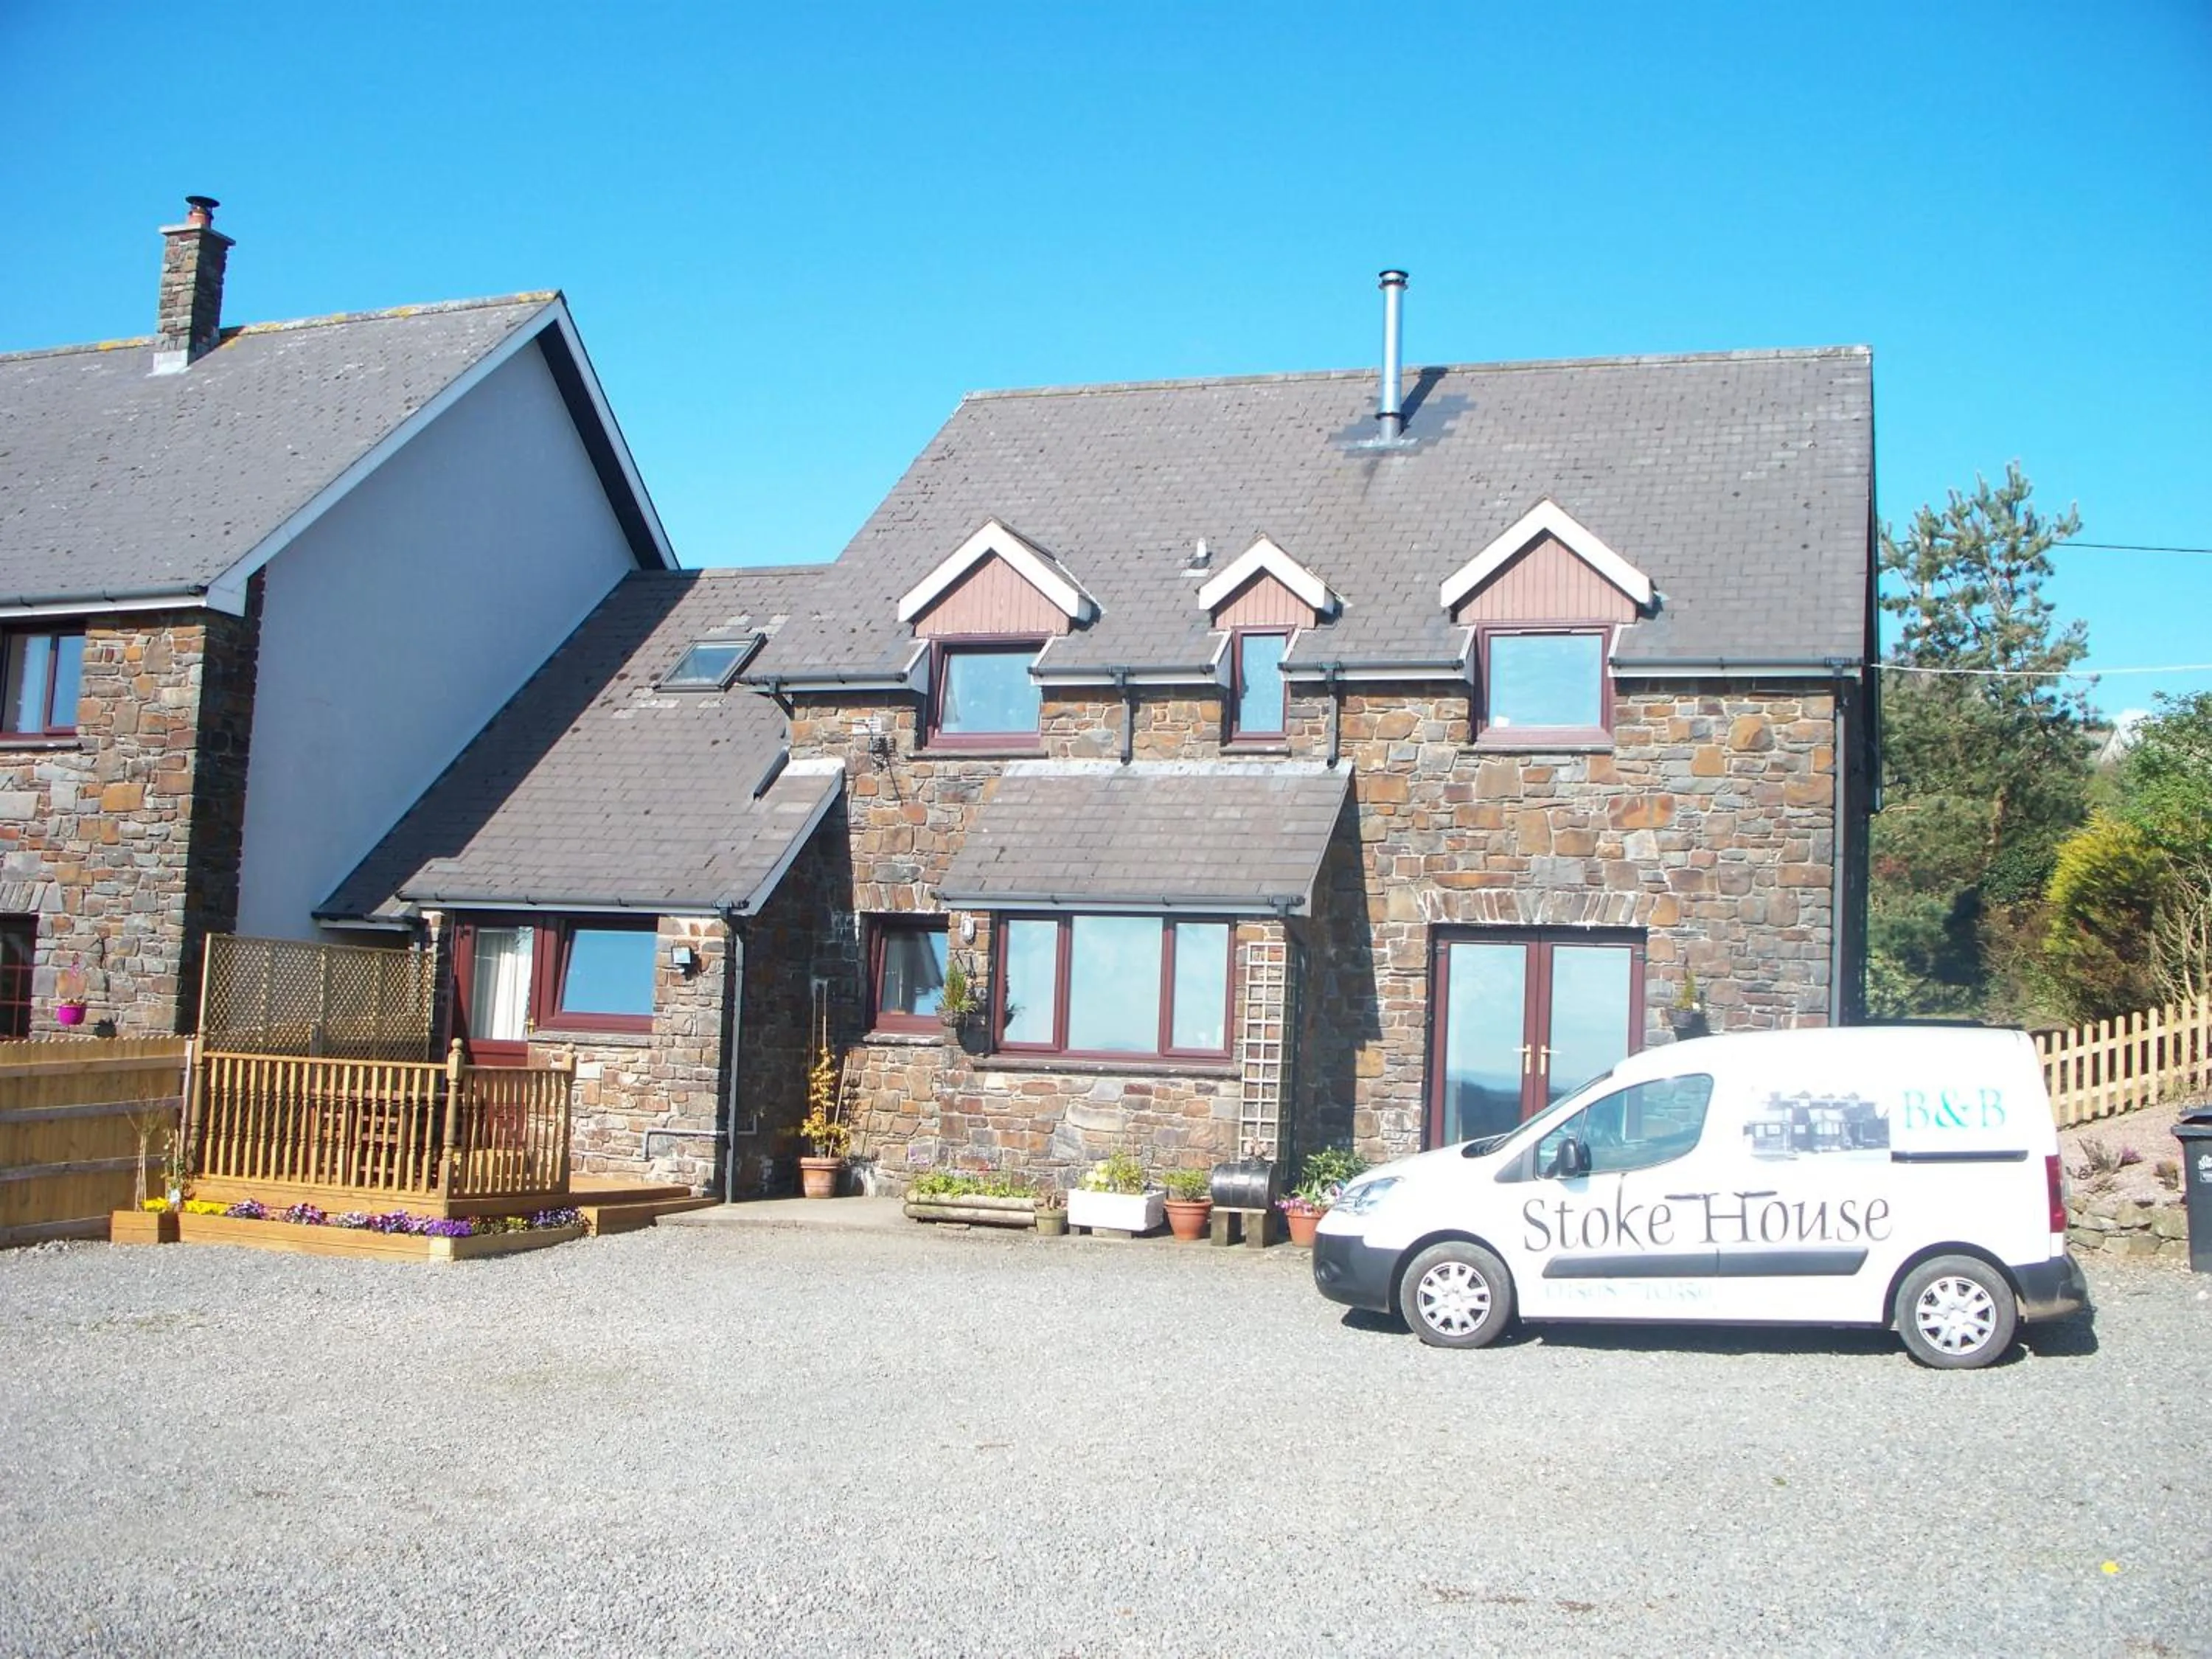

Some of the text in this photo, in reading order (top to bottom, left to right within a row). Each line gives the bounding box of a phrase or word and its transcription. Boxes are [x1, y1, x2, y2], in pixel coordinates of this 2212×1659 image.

[1903, 1086, 2006, 1129] B&B
[1523, 1180, 1893, 1252] Stoke House
